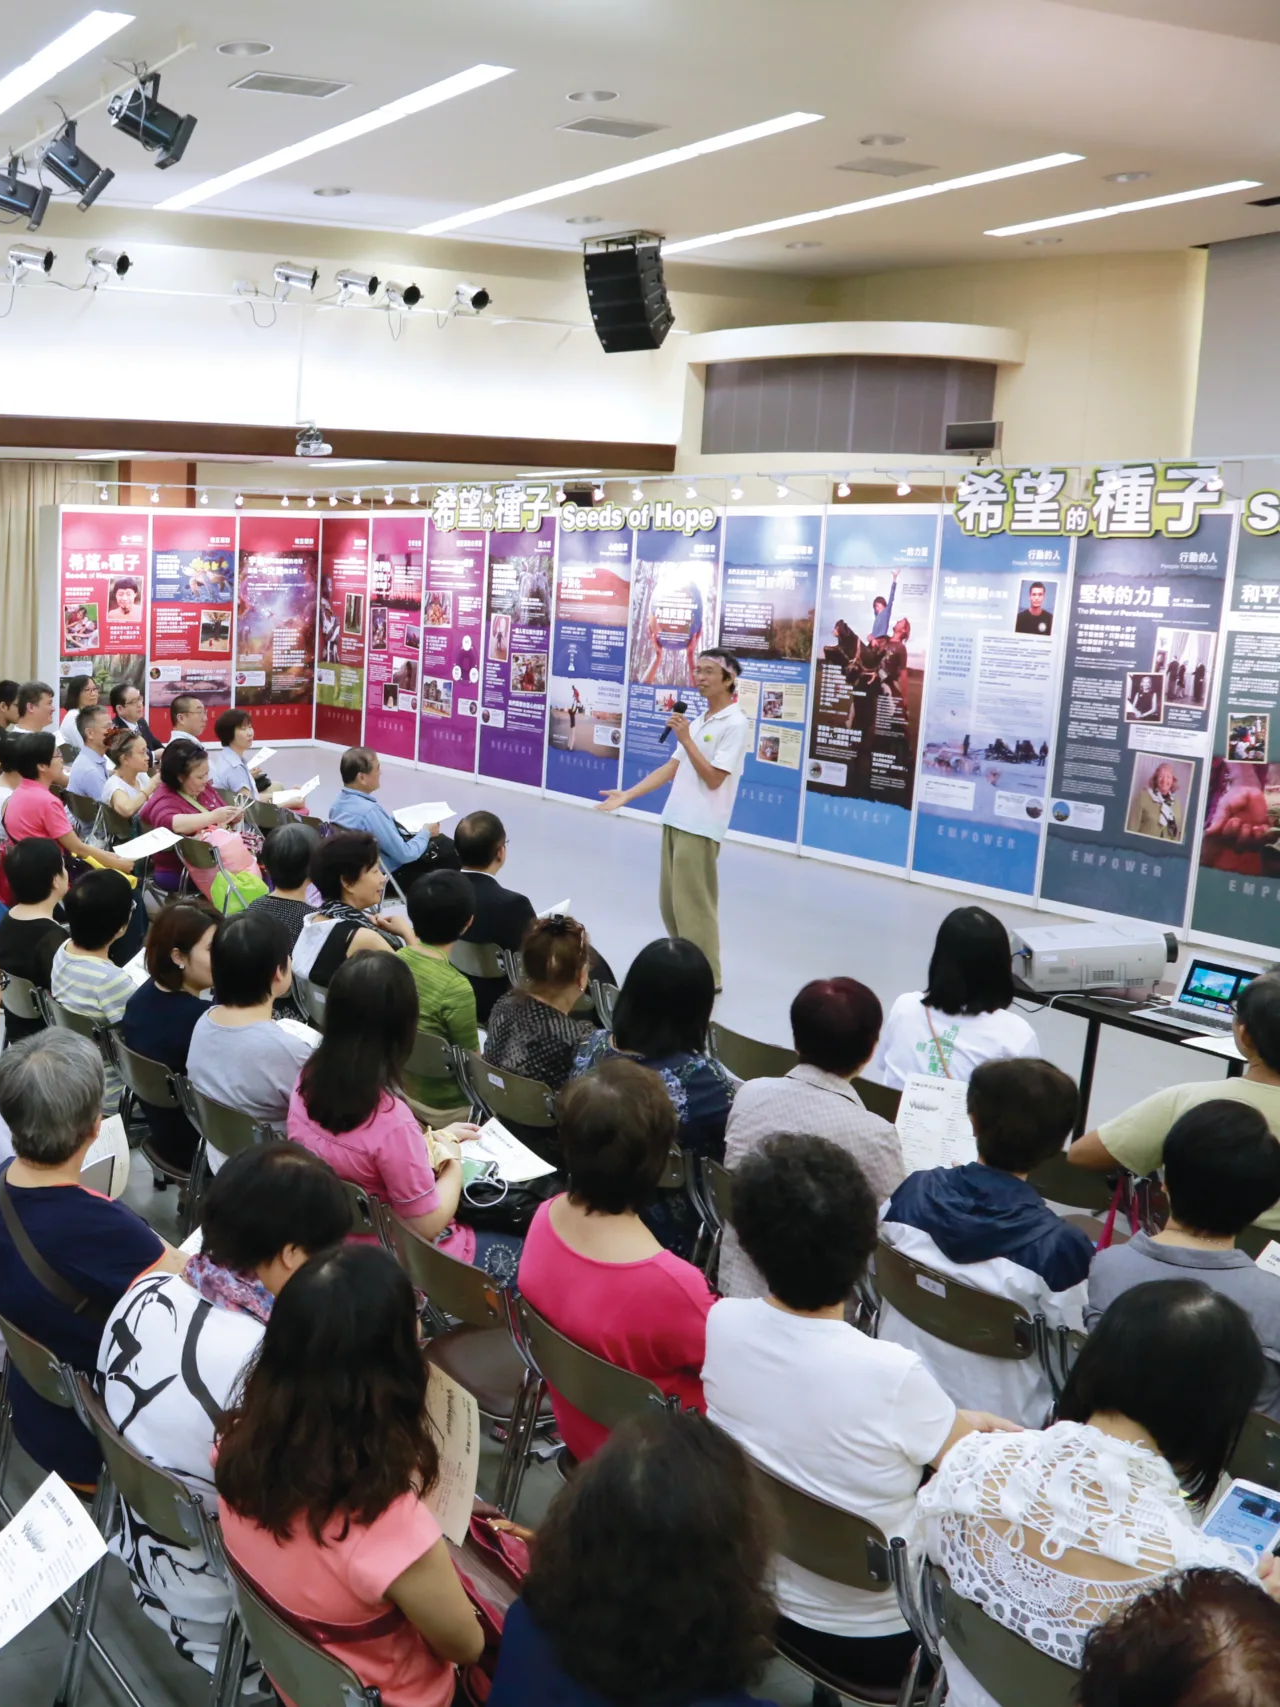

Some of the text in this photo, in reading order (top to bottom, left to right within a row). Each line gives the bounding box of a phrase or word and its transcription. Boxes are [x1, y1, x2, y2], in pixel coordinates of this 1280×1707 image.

[432, 486, 551, 529] 希望的種子
[957, 466, 1220, 532] 希望的種子
[562, 502, 715, 534] Seeds of Hope
[68, 553, 141, 572] 希望的種子
[1027, 549, 1060, 561] 行動的人
[1179, 552, 1218, 564] 行動的人
[1160, 563, 1179, 571] People
[1078, 584, 1171, 607] 堅持的力量
[1241, 584, 1280, 604] 和平
[1077, 607, 1089, 615] The
[1089, 608, 1113, 616] Power
[491, 740, 532, 755] REFLECT
[559, 754, 607, 771] REFLECT
[741, 788, 784, 805] FLECT
[823, 802, 892, 825] REFLECT
[937, 824, 1016, 850] EMPOWER
[1071, 850, 1163, 878] EMPOWER
